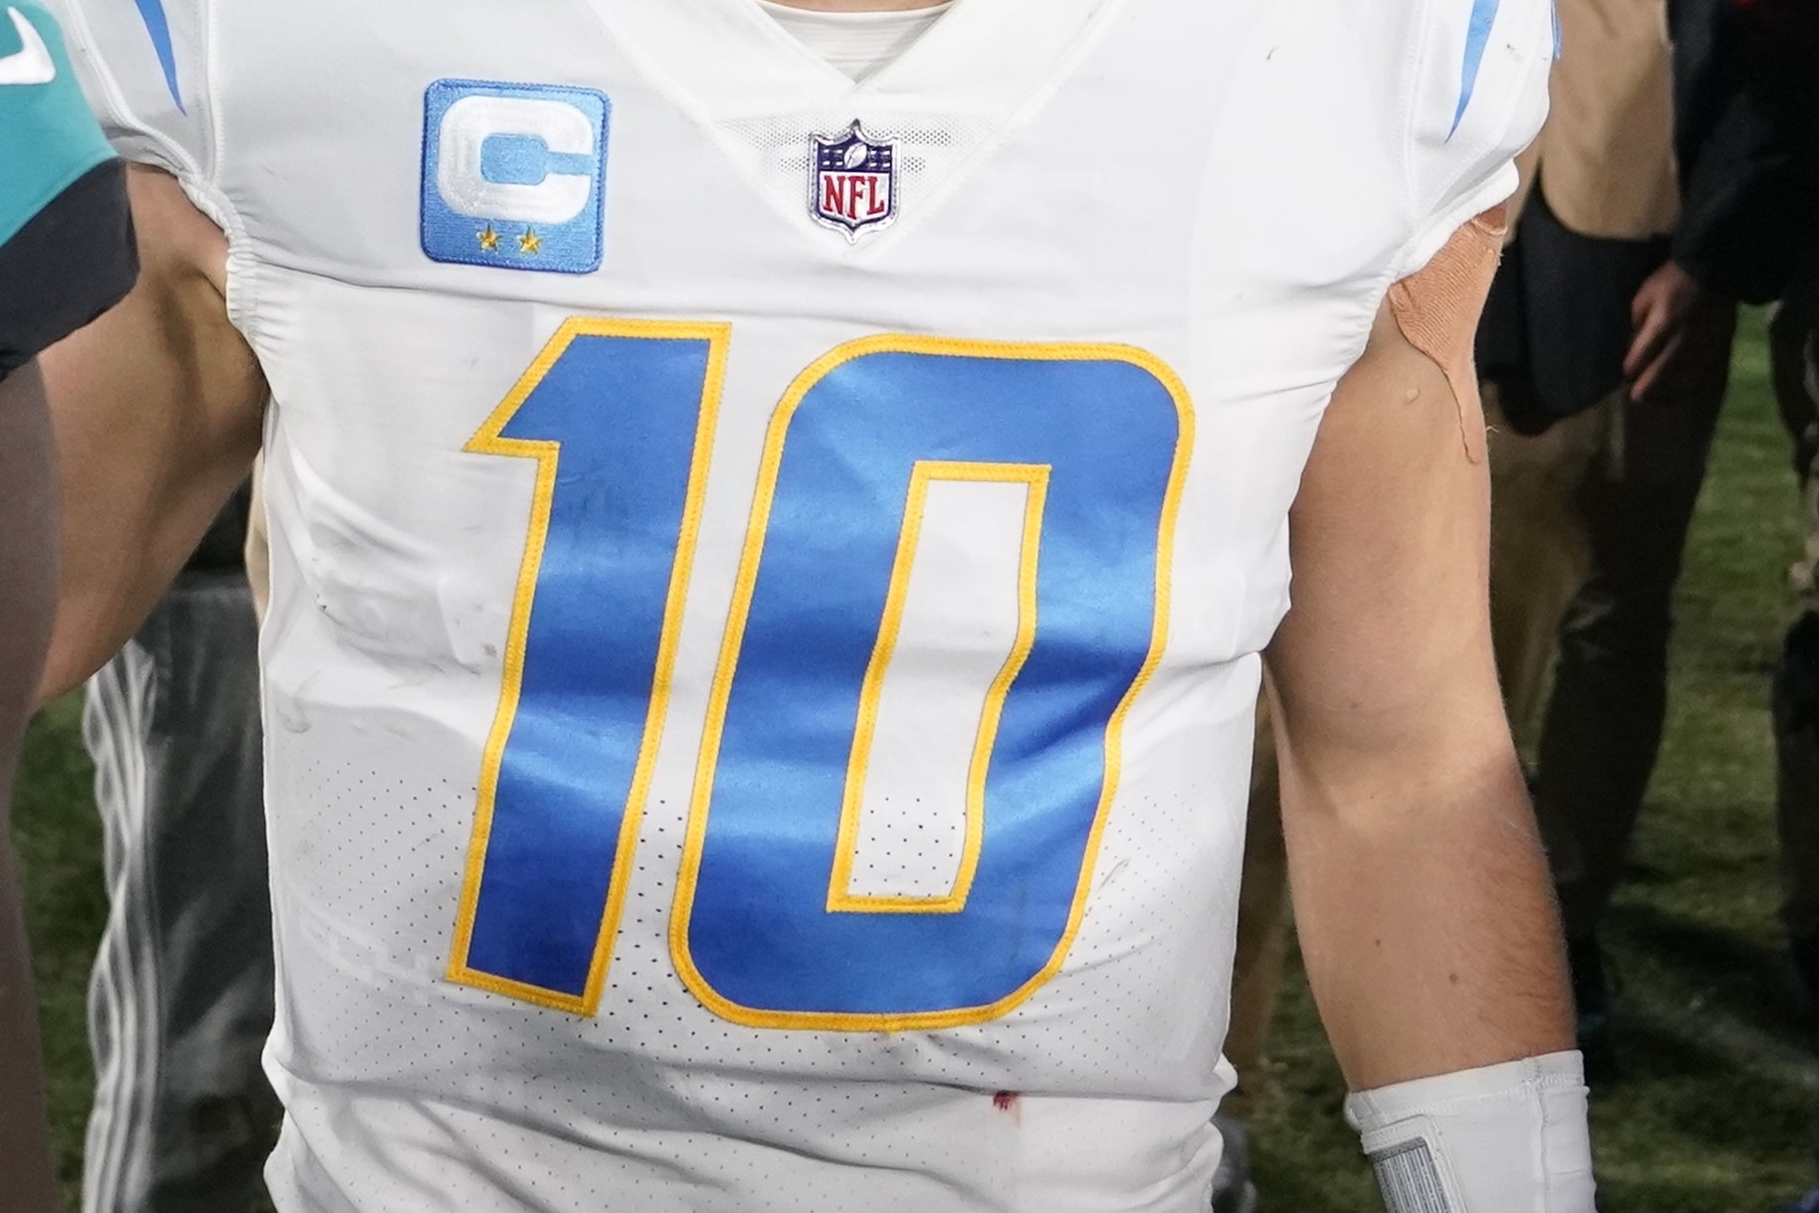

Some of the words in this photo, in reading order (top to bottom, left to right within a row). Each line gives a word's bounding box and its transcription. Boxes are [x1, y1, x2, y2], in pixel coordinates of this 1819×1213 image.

[437, 94, 594, 224] C
[822, 174, 886, 221] NFL
[445, 316, 1198, 1034] 10
